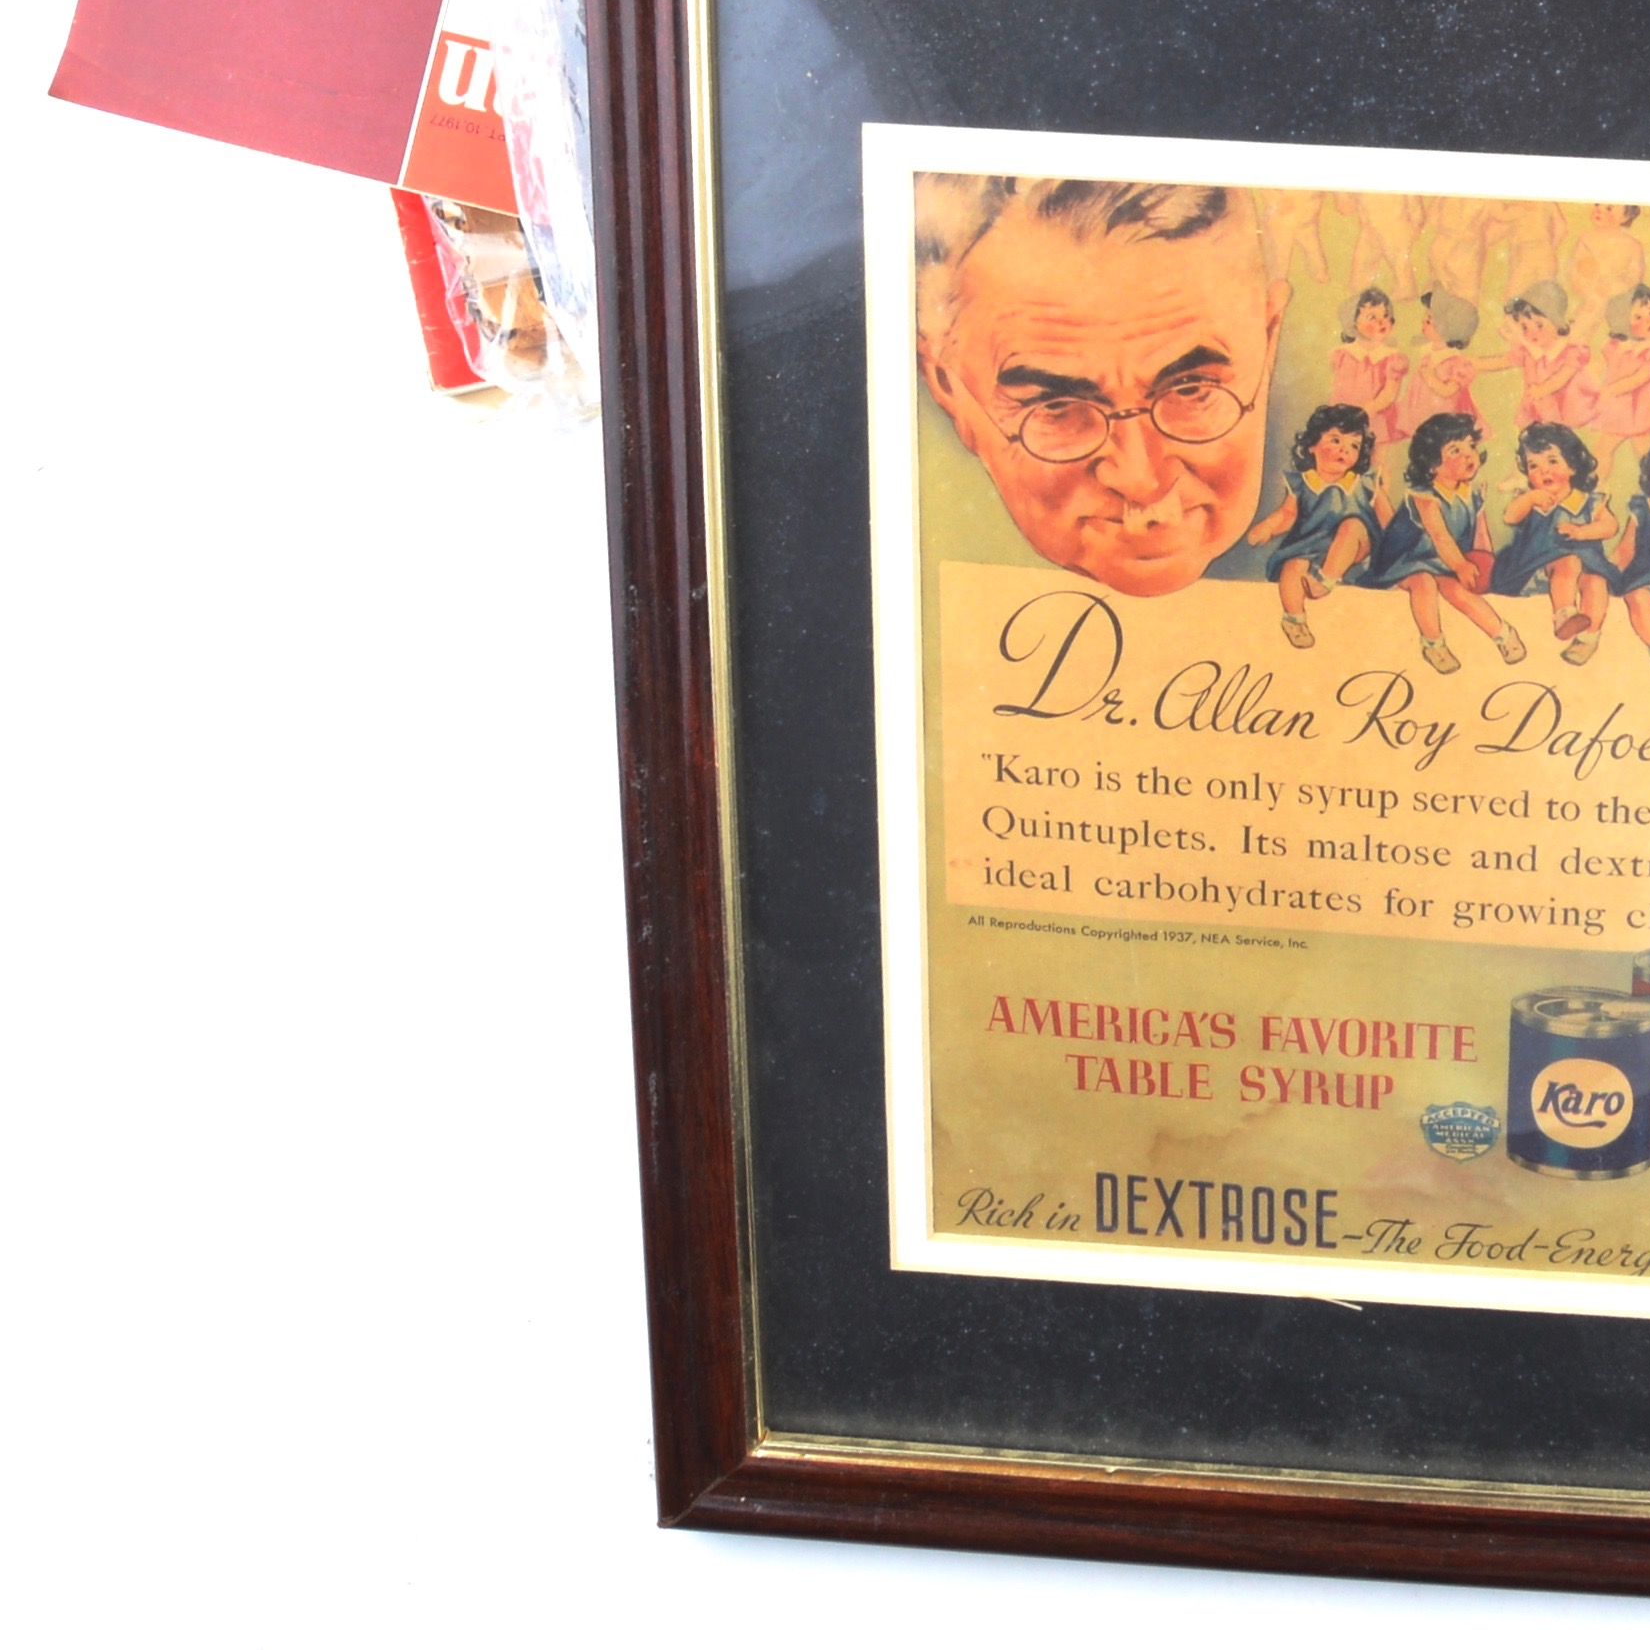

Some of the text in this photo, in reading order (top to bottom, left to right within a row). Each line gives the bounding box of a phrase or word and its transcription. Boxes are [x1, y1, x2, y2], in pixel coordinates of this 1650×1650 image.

[993, 590, 1137, 726] Dr.
[1154, 660, 1320, 740] Allan
[1336, 668, 1460, 773] Roy
[1094, 760, 1122, 793] is
[1136, 767, 1193, 797] the
[1205, 772, 1286, 812] only
[1297, 781, 1399, 819] syrup
[1412, 790, 1530, 819] served
[1545, 798, 1581, 823] to
[982, 805, 1216, 855] Quintuplets.
[1241, 825, 1288, 857] Its
[1307, 833, 1452, 867] maltose
[1470, 845, 1538, 874] and
[982, 857, 1073, 893] ideal
[1094, 872, 1363, 915] carbohydrates
[1383, 888, 1435, 918] for
[1452, 897, 1606, 936] growing
[968, 915, 1309, 950] All Reproductions Copyrighted 1937, NEA Service, Inc.
[986, 994, 1478, 1063] AMERICA'S FAVORITE
[1064, 1052, 1395, 1112] TABLE SYRUP
[1537, 1081, 1626, 1129] Karo
[955, 1186, 1047, 1230] Rich
[1045, 1201, 1082, 1233] in
[1094, 1170, 1339, 1250] DEXTROSE
